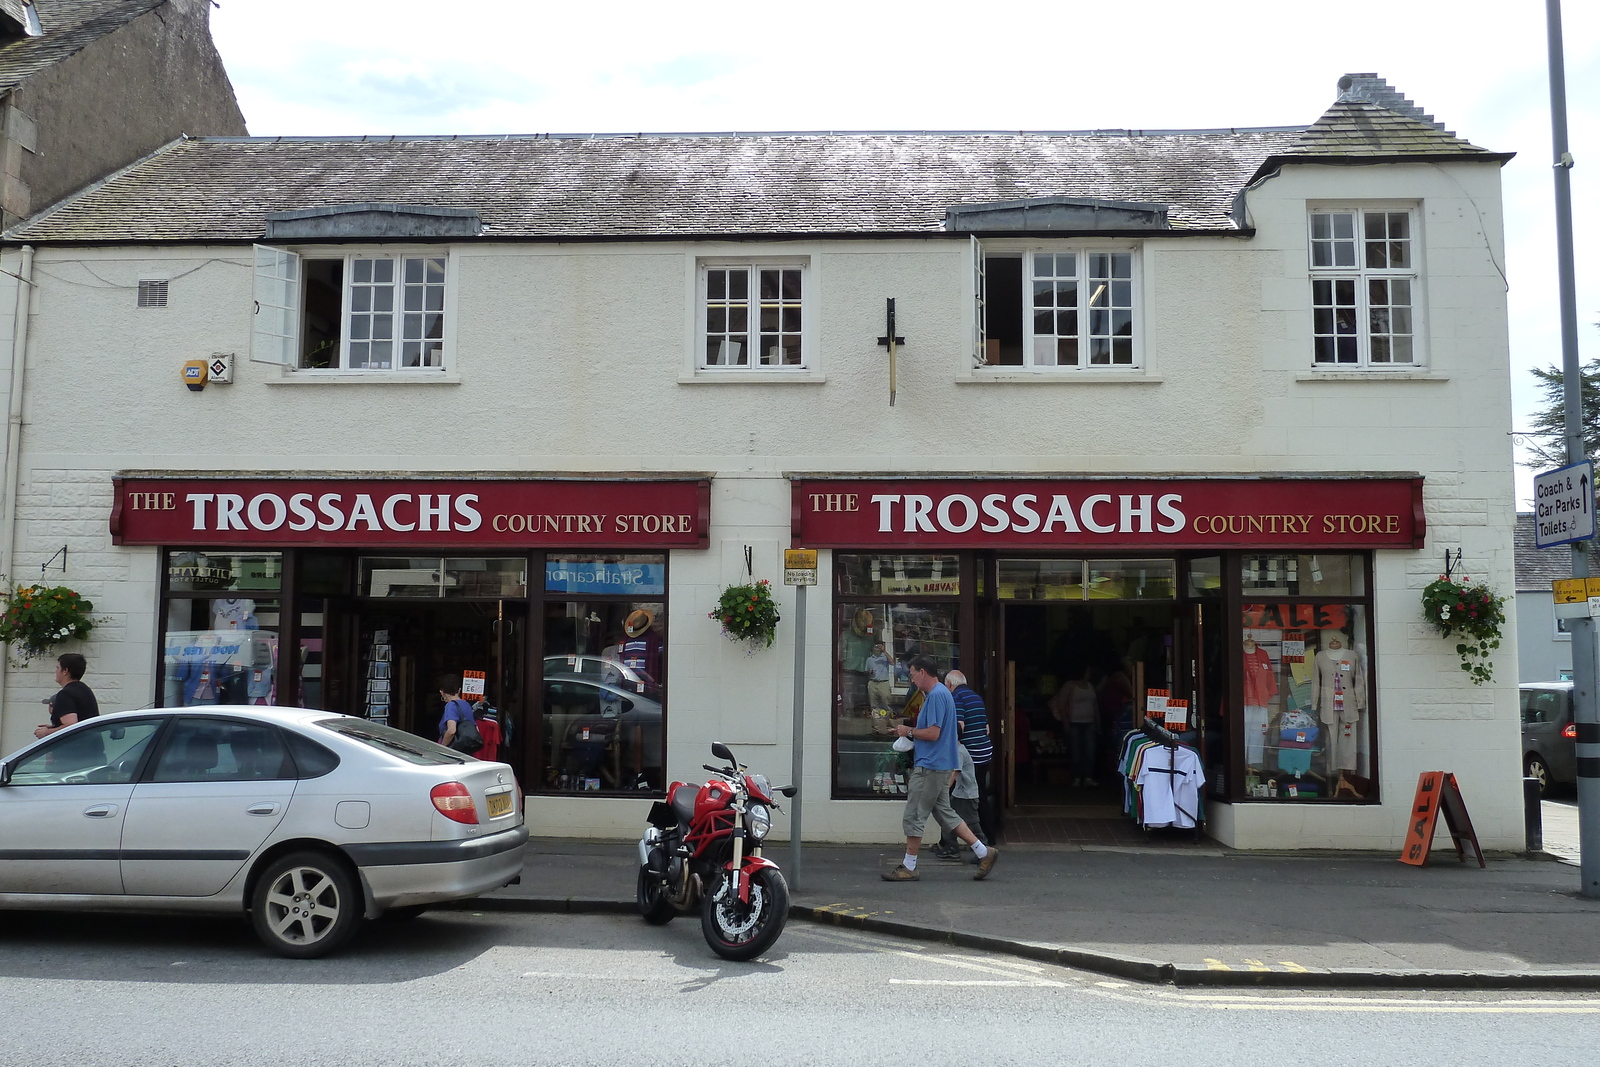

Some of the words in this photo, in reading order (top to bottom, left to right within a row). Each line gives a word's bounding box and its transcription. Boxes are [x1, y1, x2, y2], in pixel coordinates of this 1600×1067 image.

[1537, 480, 1564, 499] Coach
[1566, 476, 1573, 491] &
[129, 492, 176, 510] THE
[186, 493, 482, 532] TROSSACHS
[492, 514, 606, 533] COUNTRY
[615, 514, 693, 533] STORE
[809, 493, 860, 512] THE
[870, 493, 1186, 533] TROSSACHS
[1193, 514, 1313, 534] COUNTRY
[1323, 514, 1400, 534] STORE
[1538, 503, 1553, 518] Car
[1555, 497, 1580, 514] Parks
[1539, 520, 1567, 537] Toilets
[1409, 776, 1434, 860] SALE
